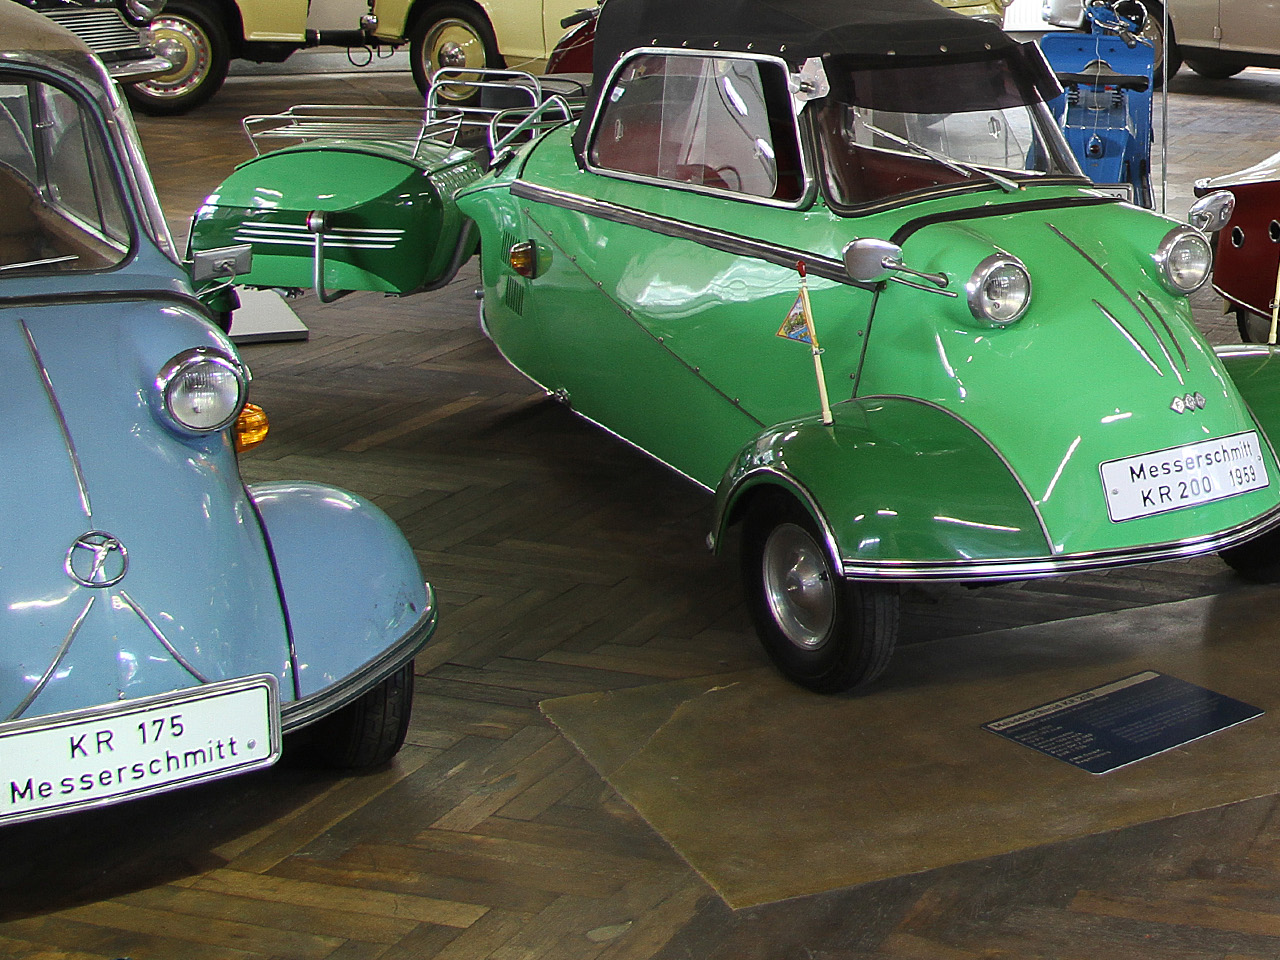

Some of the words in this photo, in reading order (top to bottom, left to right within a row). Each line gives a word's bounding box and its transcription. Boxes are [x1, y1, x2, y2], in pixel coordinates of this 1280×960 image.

[1129, 440, 1253, 483] Messerschmitt
[1141, 485, 1172, 508] KR
[1178, 475, 1212, 499] 200
[1229, 464, 1256, 487] 1959
[69, 730, 115, 759] KR
[137, 714, 185, 746] 175
[10, 735, 239, 804] Messerschmitt
